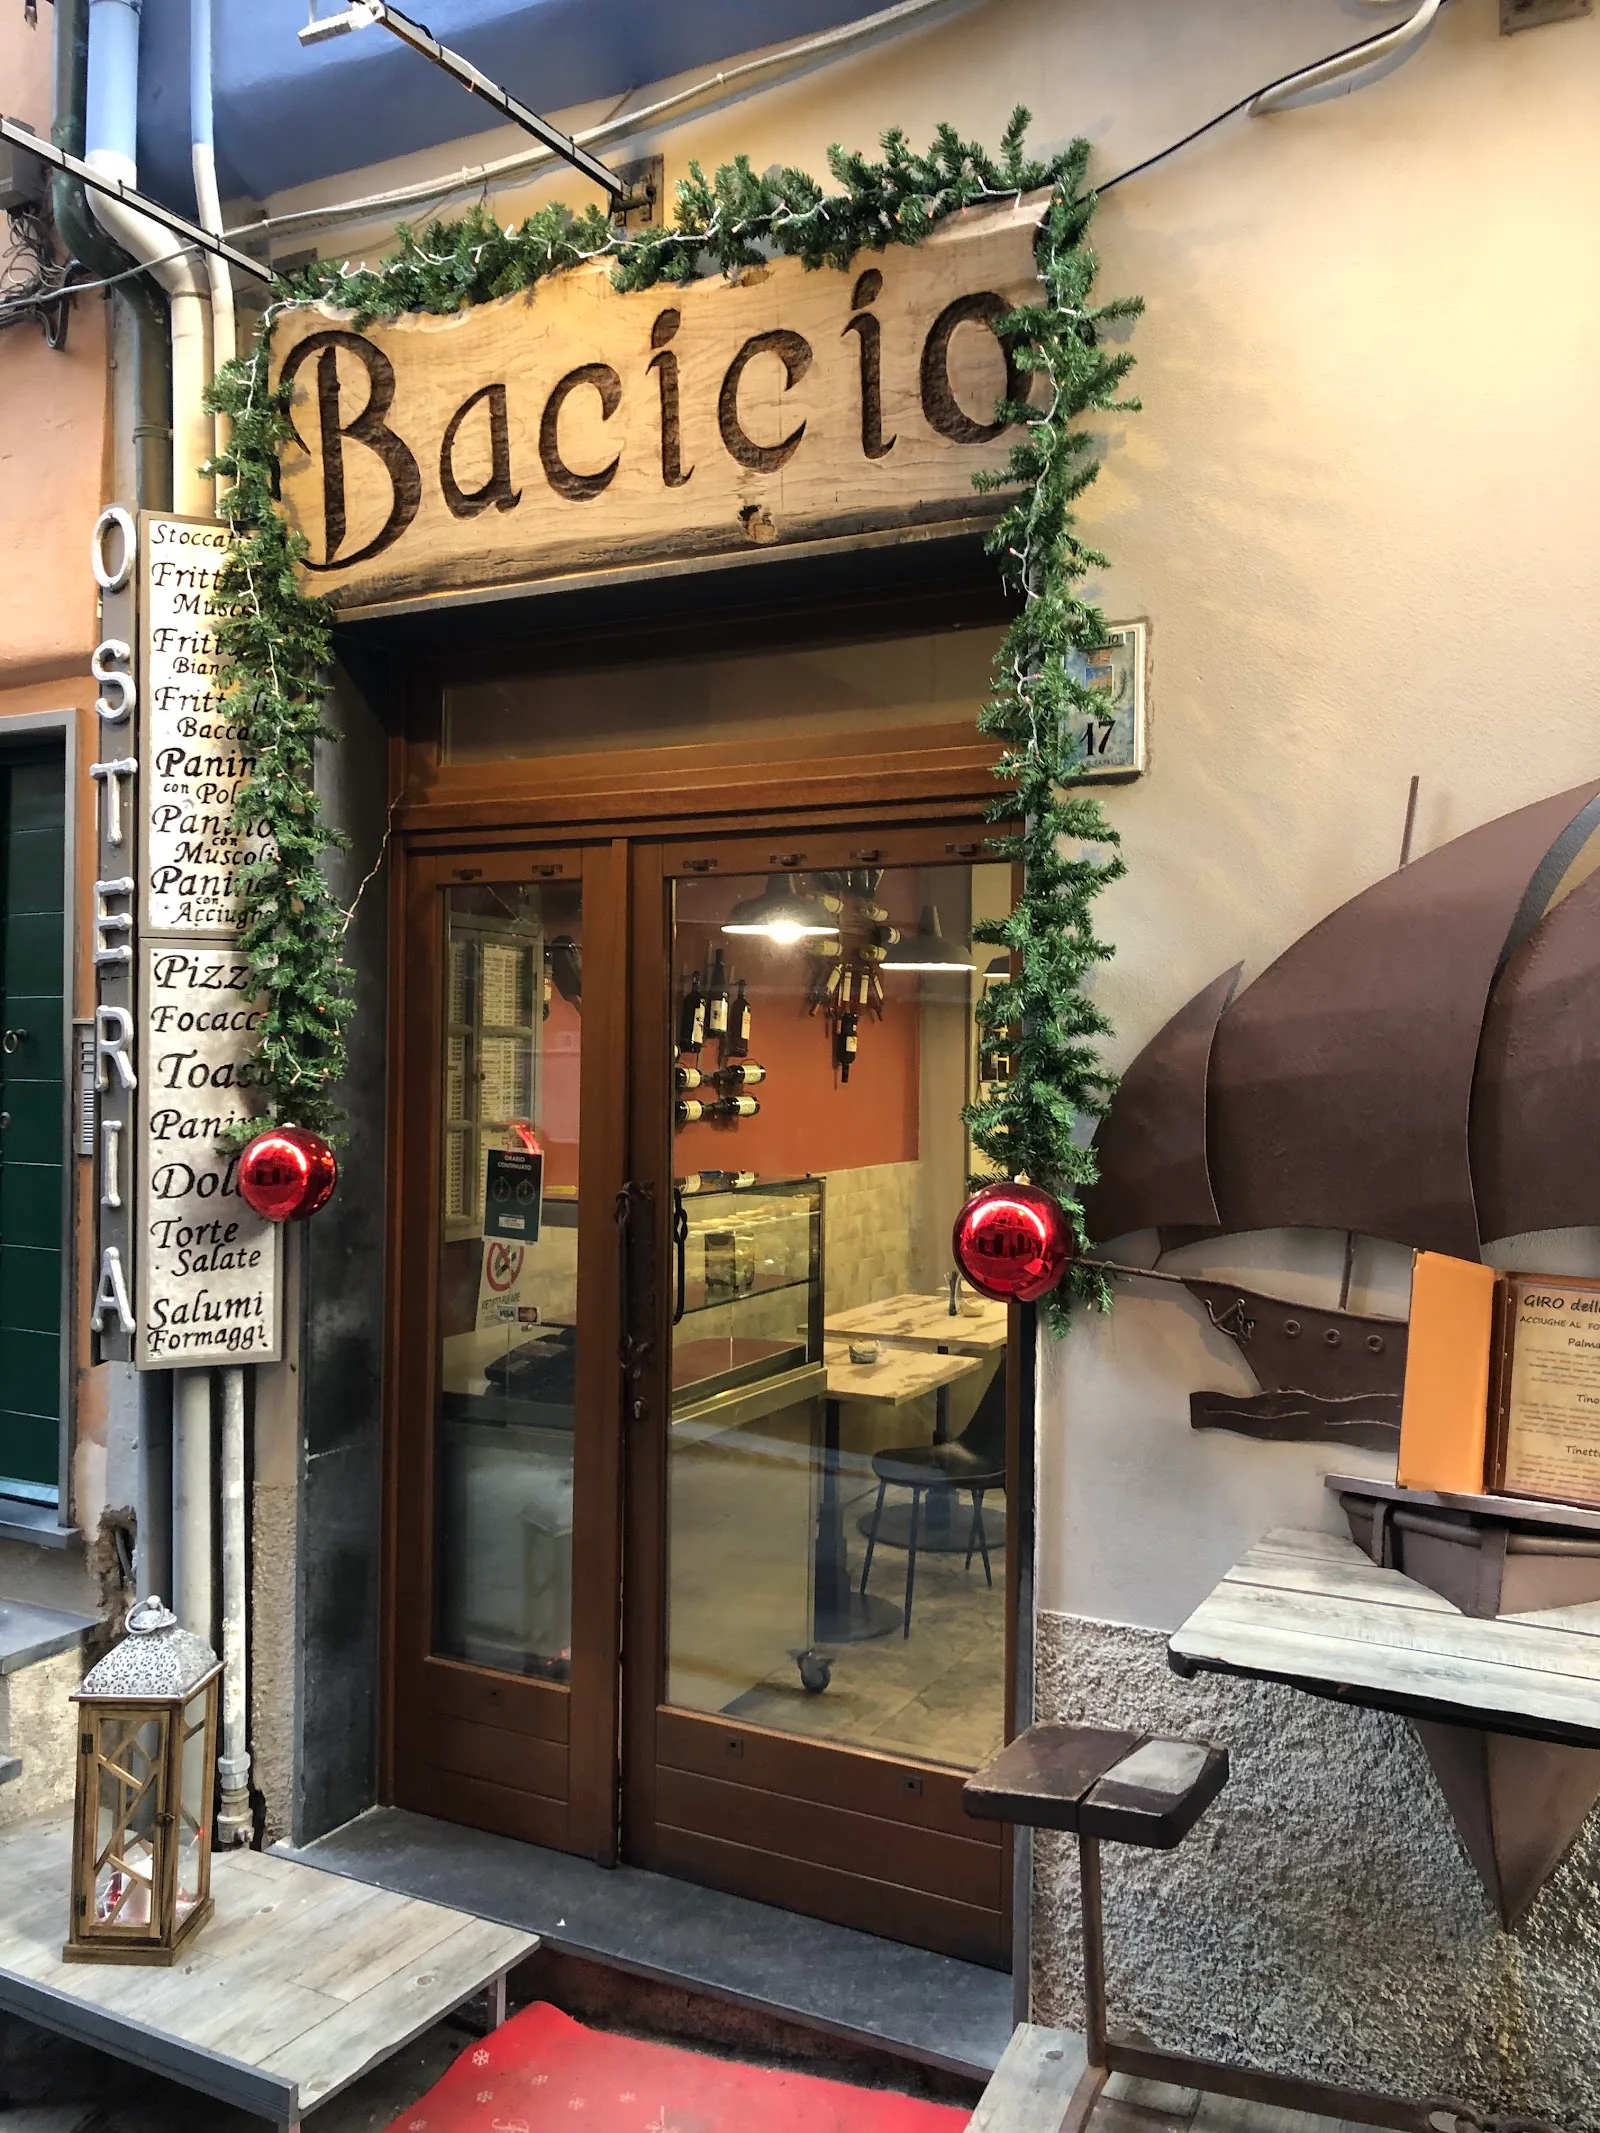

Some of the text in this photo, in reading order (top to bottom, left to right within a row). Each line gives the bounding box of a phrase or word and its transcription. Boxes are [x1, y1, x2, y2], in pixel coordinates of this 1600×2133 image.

[280, 267, 1036, 571] Bacicio
[151, 562, 224, 591] Fritt
[153, 627, 233, 656] Fritt
[154, 686, 227, 714] Fritt
[176, 716, 250, 741] Bacca
[1080, 720, 1116, 756] 17
[155, 746, 257, 778] Panin
[163, 780, 242, 804] con Pol
[211, 836, 239, 847] con
[196, 896, 219, 905] con
[90, 507, 138, 1334] OSTERIA
[153, 954, 249, 990] Pizz
[150, 1005, 261, 1033] Focacc
[150, 1216, 239, 1249] Torte
[171, 1243, 261, 1277] Salate
[146, 1289, 263, 1331] Salumi
[1524, 1294, 1564, 1309] GIRO
[147, 1319, 265, 1352] Formaggi
[1520, 1316, 1567, 1327] ACCIUGHE
[1588, 1323, 1600, 1331] FO
[1576, 1394, 1600, 1404] Tino
